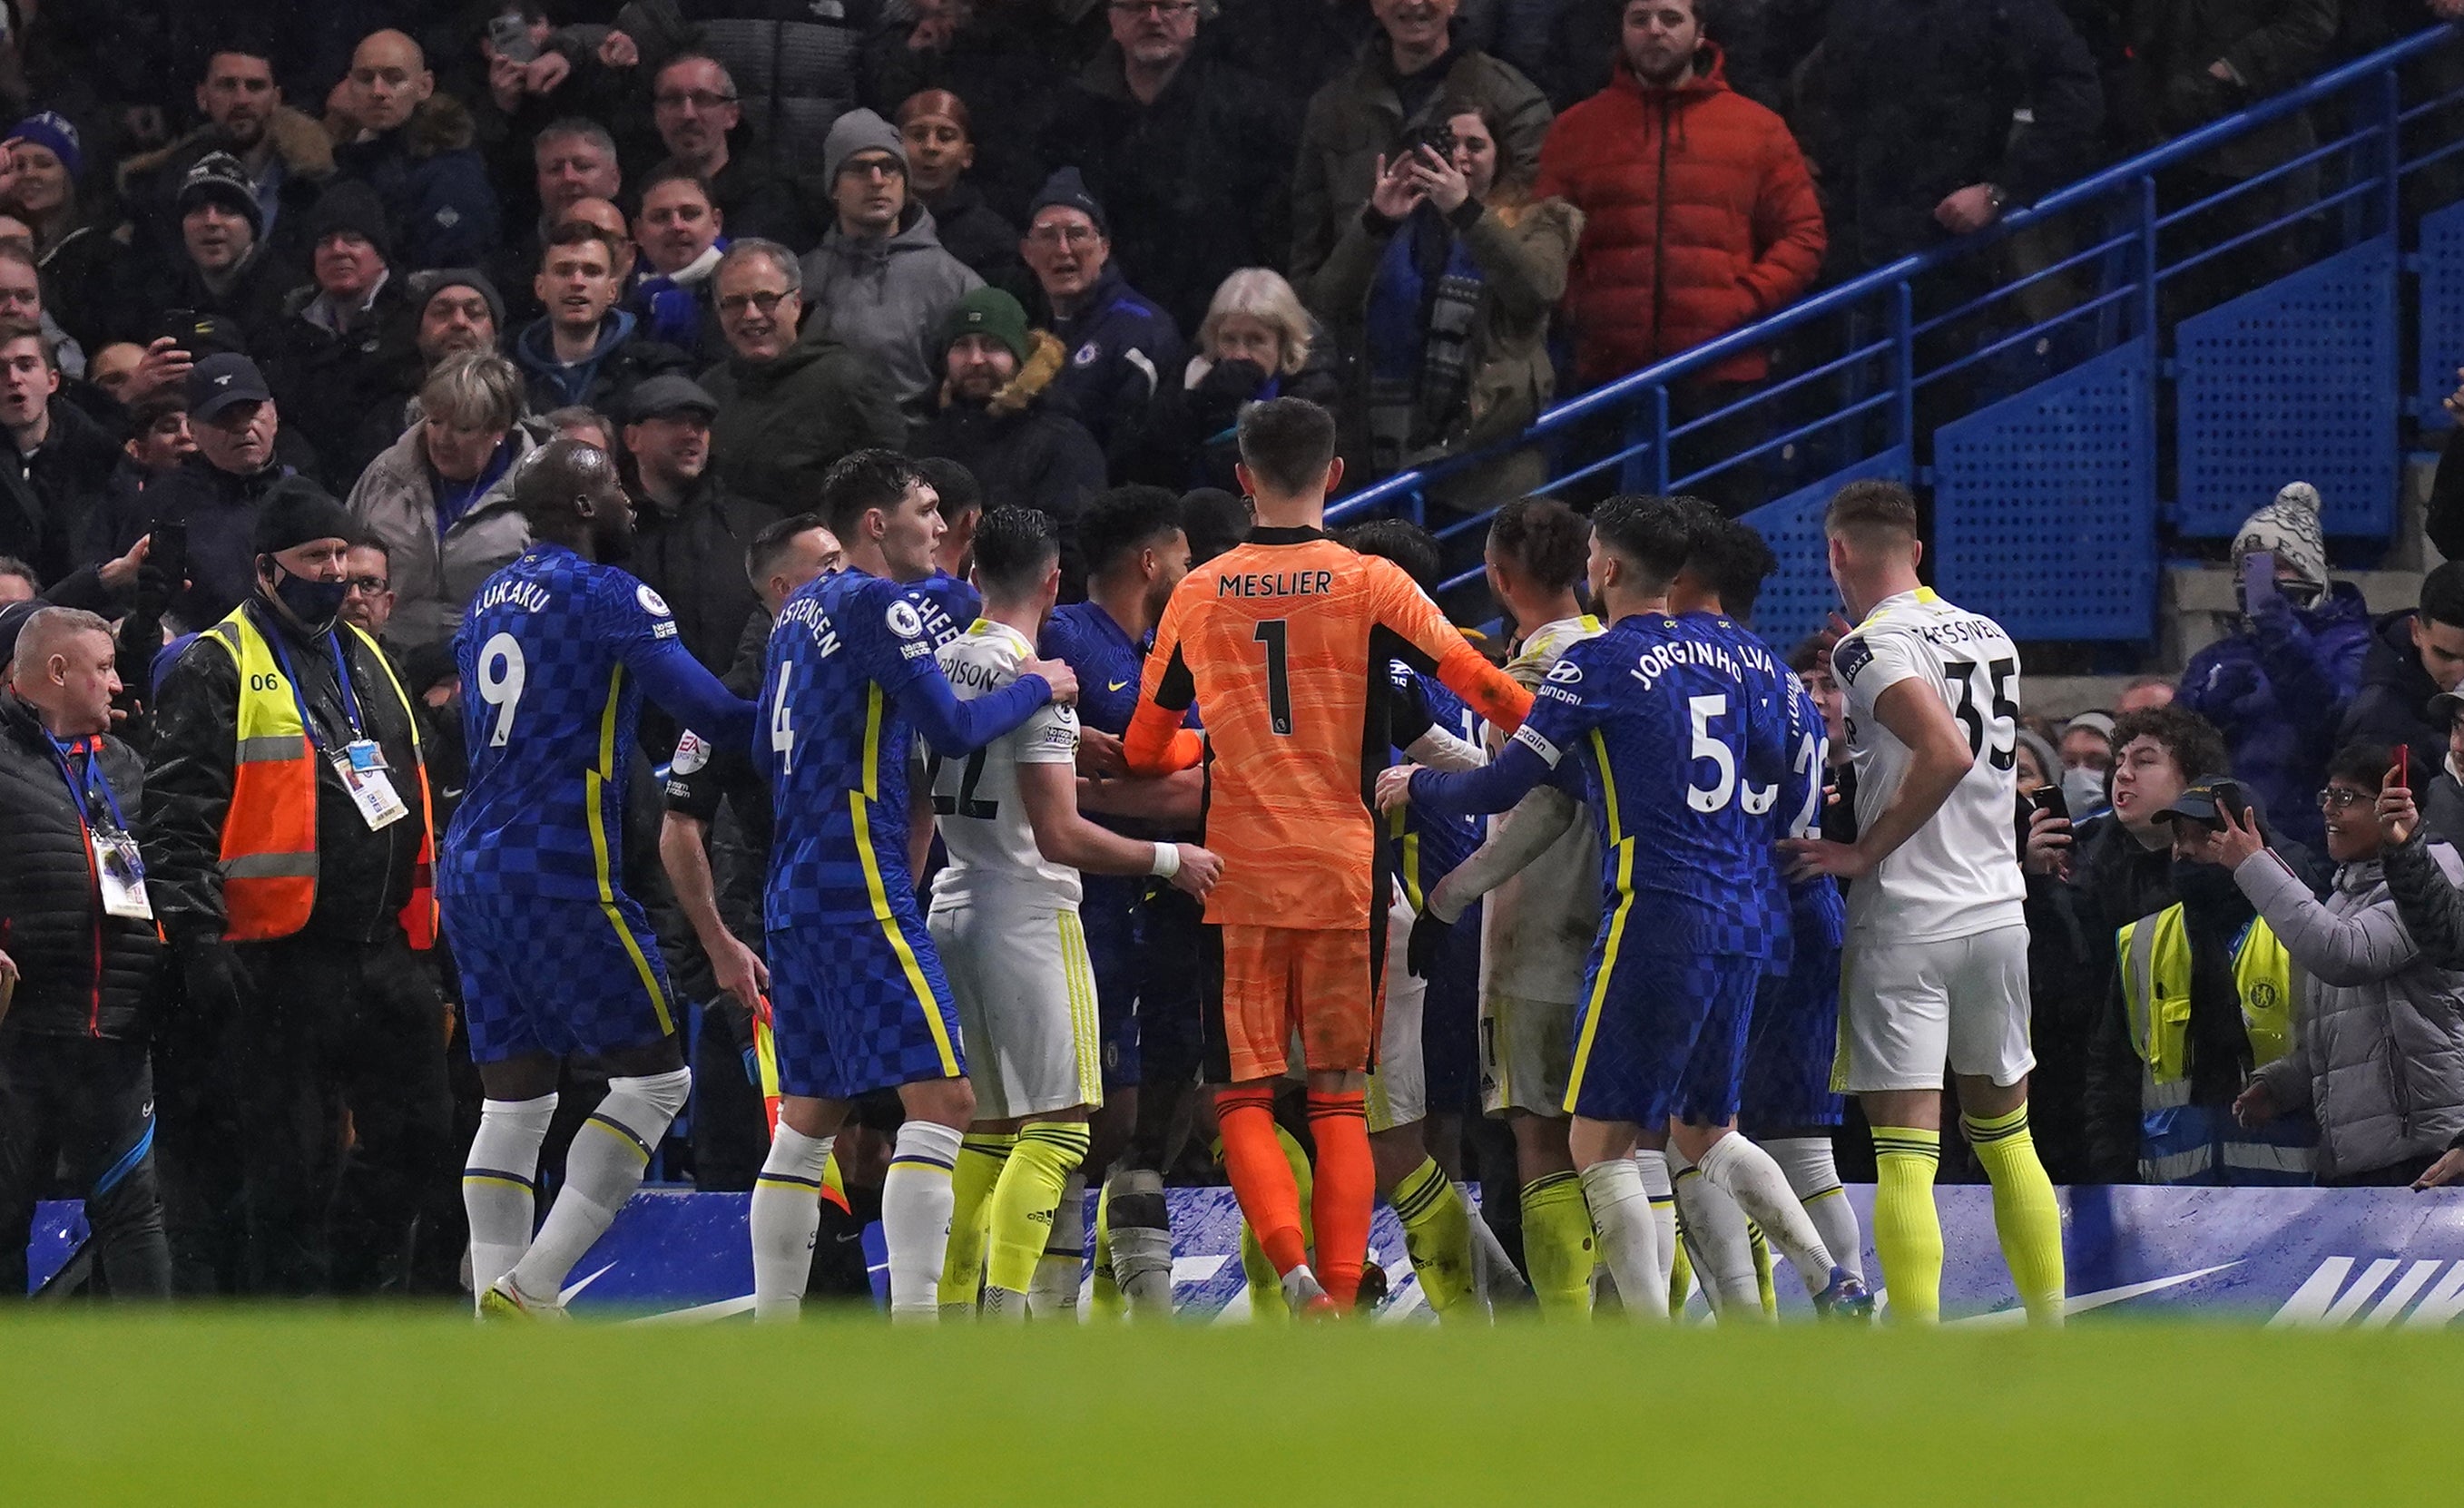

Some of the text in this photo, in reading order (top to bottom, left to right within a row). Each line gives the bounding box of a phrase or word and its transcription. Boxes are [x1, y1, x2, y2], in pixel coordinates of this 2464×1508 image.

[475, 581, 551, 618] LUKAKU
[1218, 570, 1332, 598] MESLIER
[908, 592, 960, 647] HEE
[250, 672, 278, 691] 06
[477, 632, 525, 748] 9
[1252, 618, 1293, 736] 1
[1630, 640, 1742, 691] JORGINHO
[1846, 651, 1870, 681] BOXT
[772, 661, 795, 775] 4
[1944, 658, 2018, 770] 35
[679, 735, 700, 754] EA
[1686, 694, 1735, 813] 5
